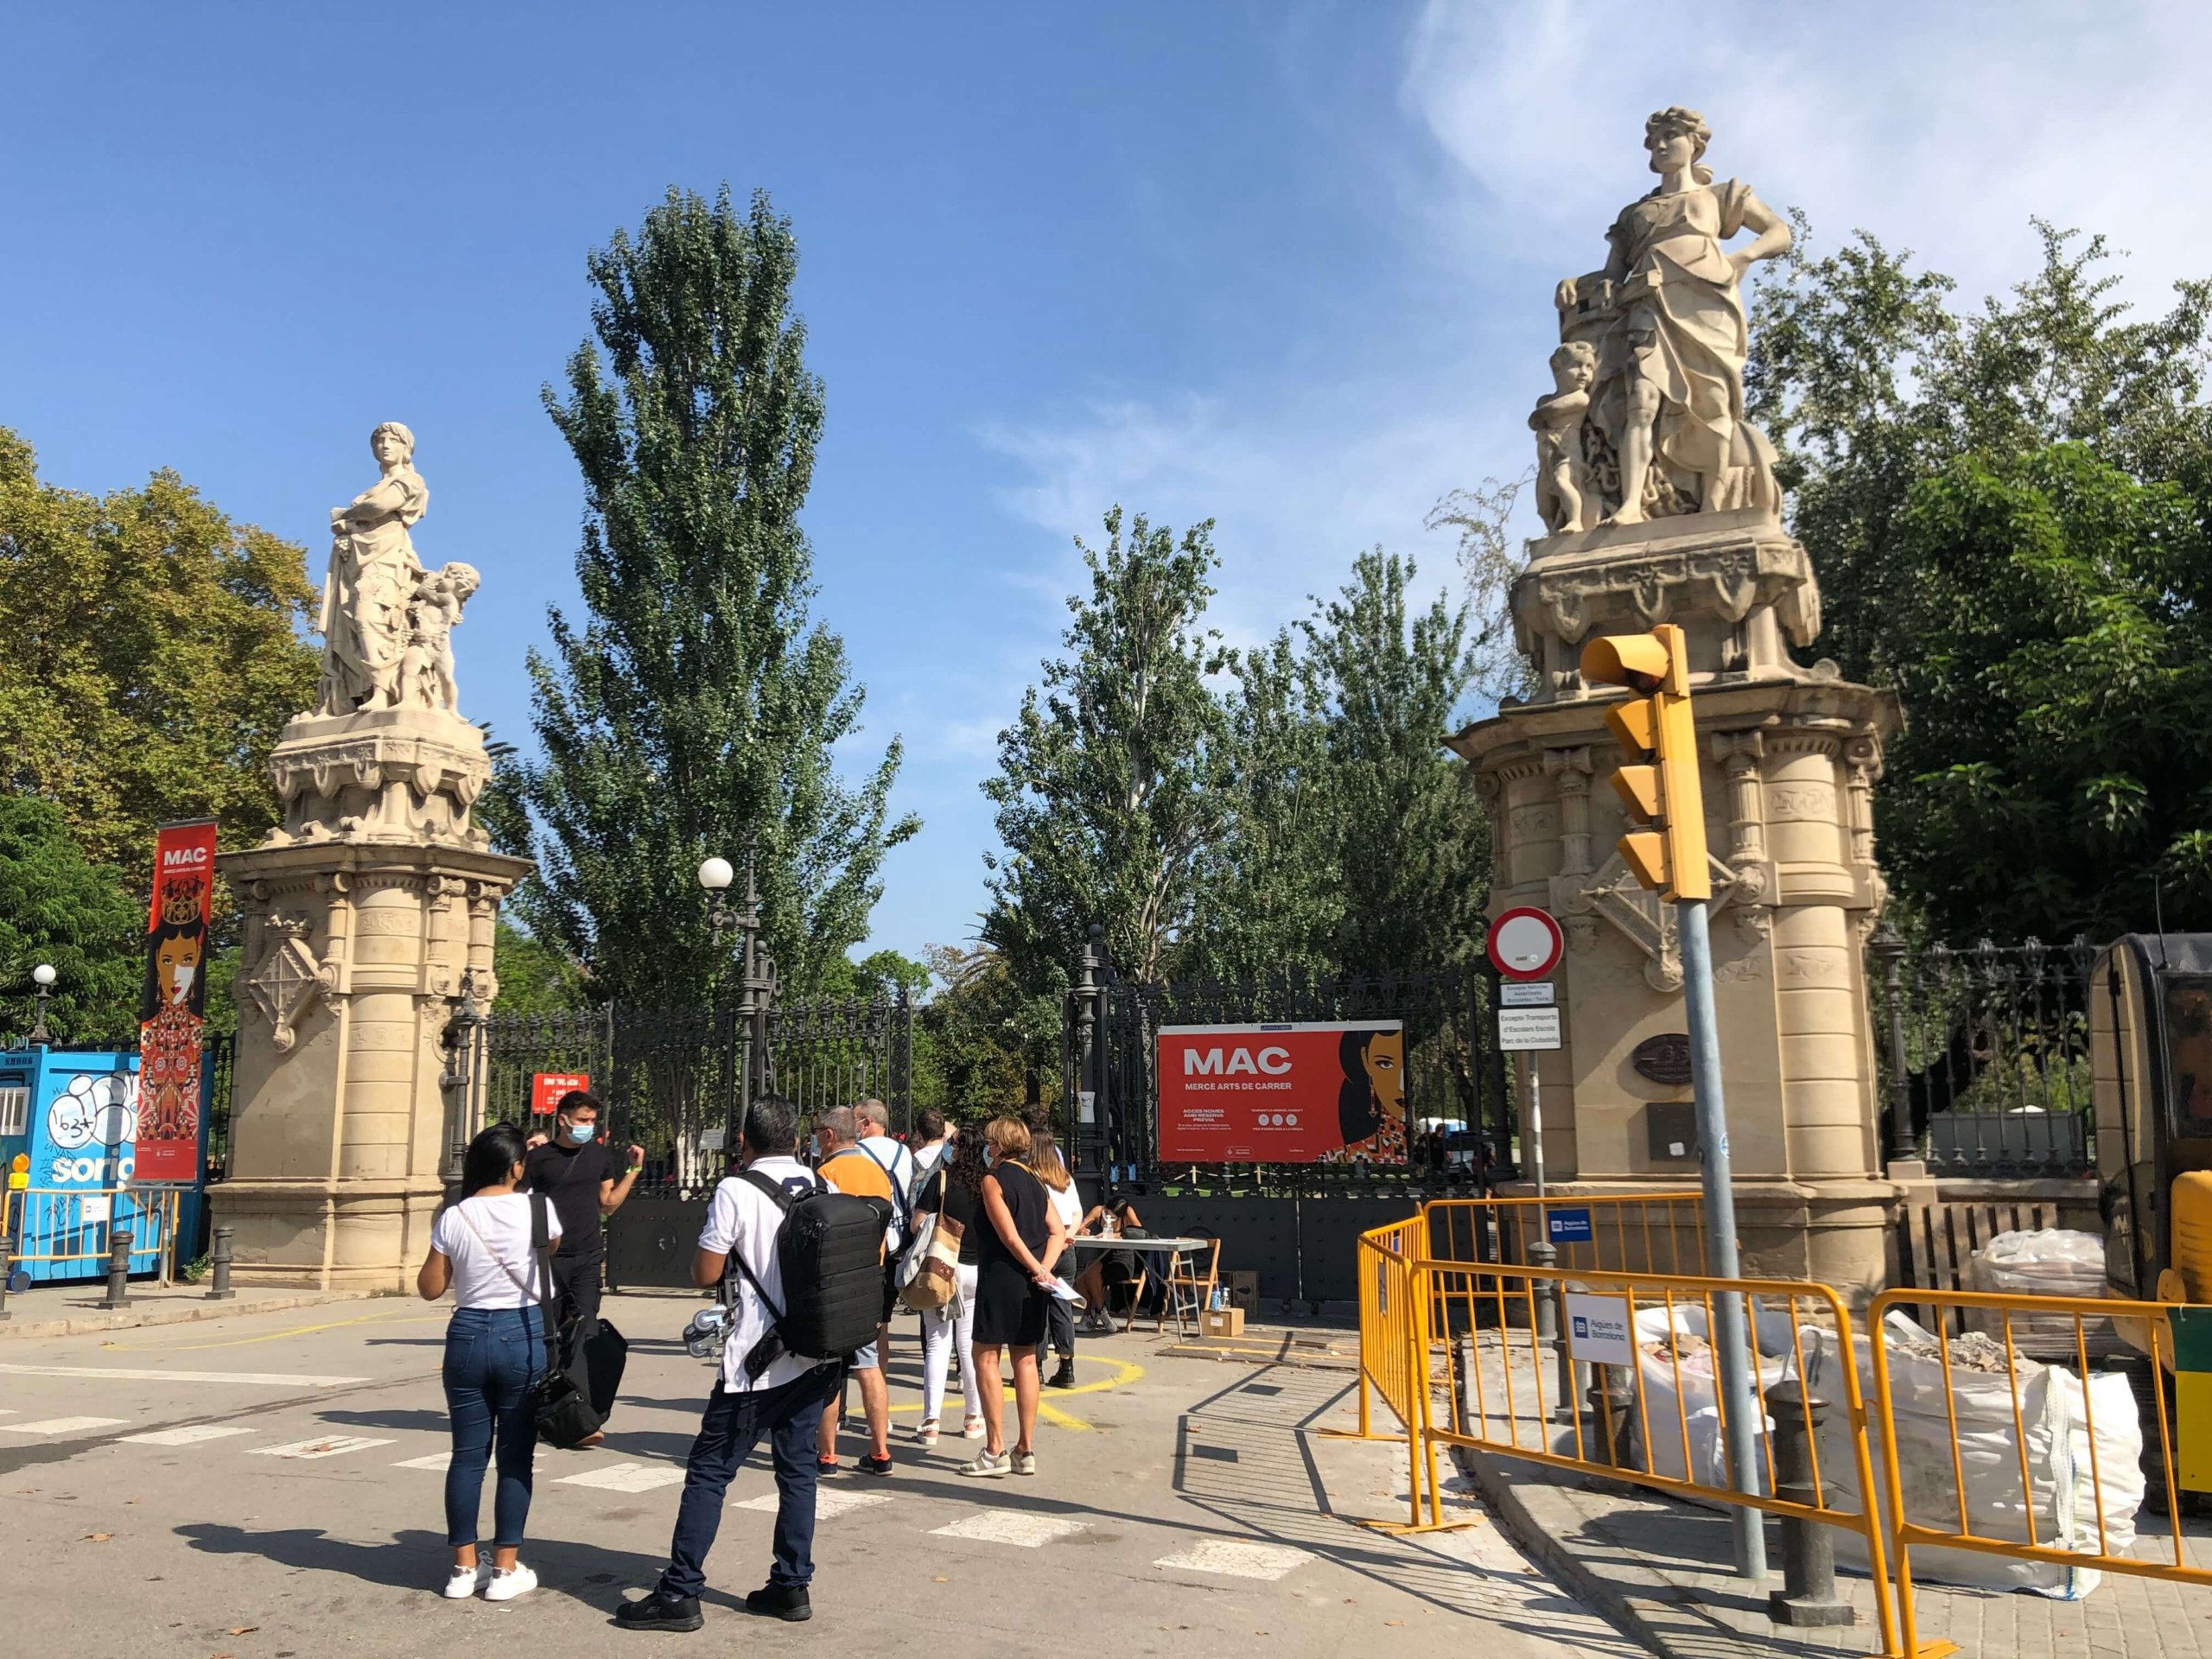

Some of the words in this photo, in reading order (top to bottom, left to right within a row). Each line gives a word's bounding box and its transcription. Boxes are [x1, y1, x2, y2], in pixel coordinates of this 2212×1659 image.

[164, 847, 207, 866] MAC
[1184, 1046, 1293, 1075] MAC
[1591, 1319, 1612, 1331] Aigües
[1614, 1321, 1624, 1331] de
[1592, 1330, 1625, 1341] Barcelona
